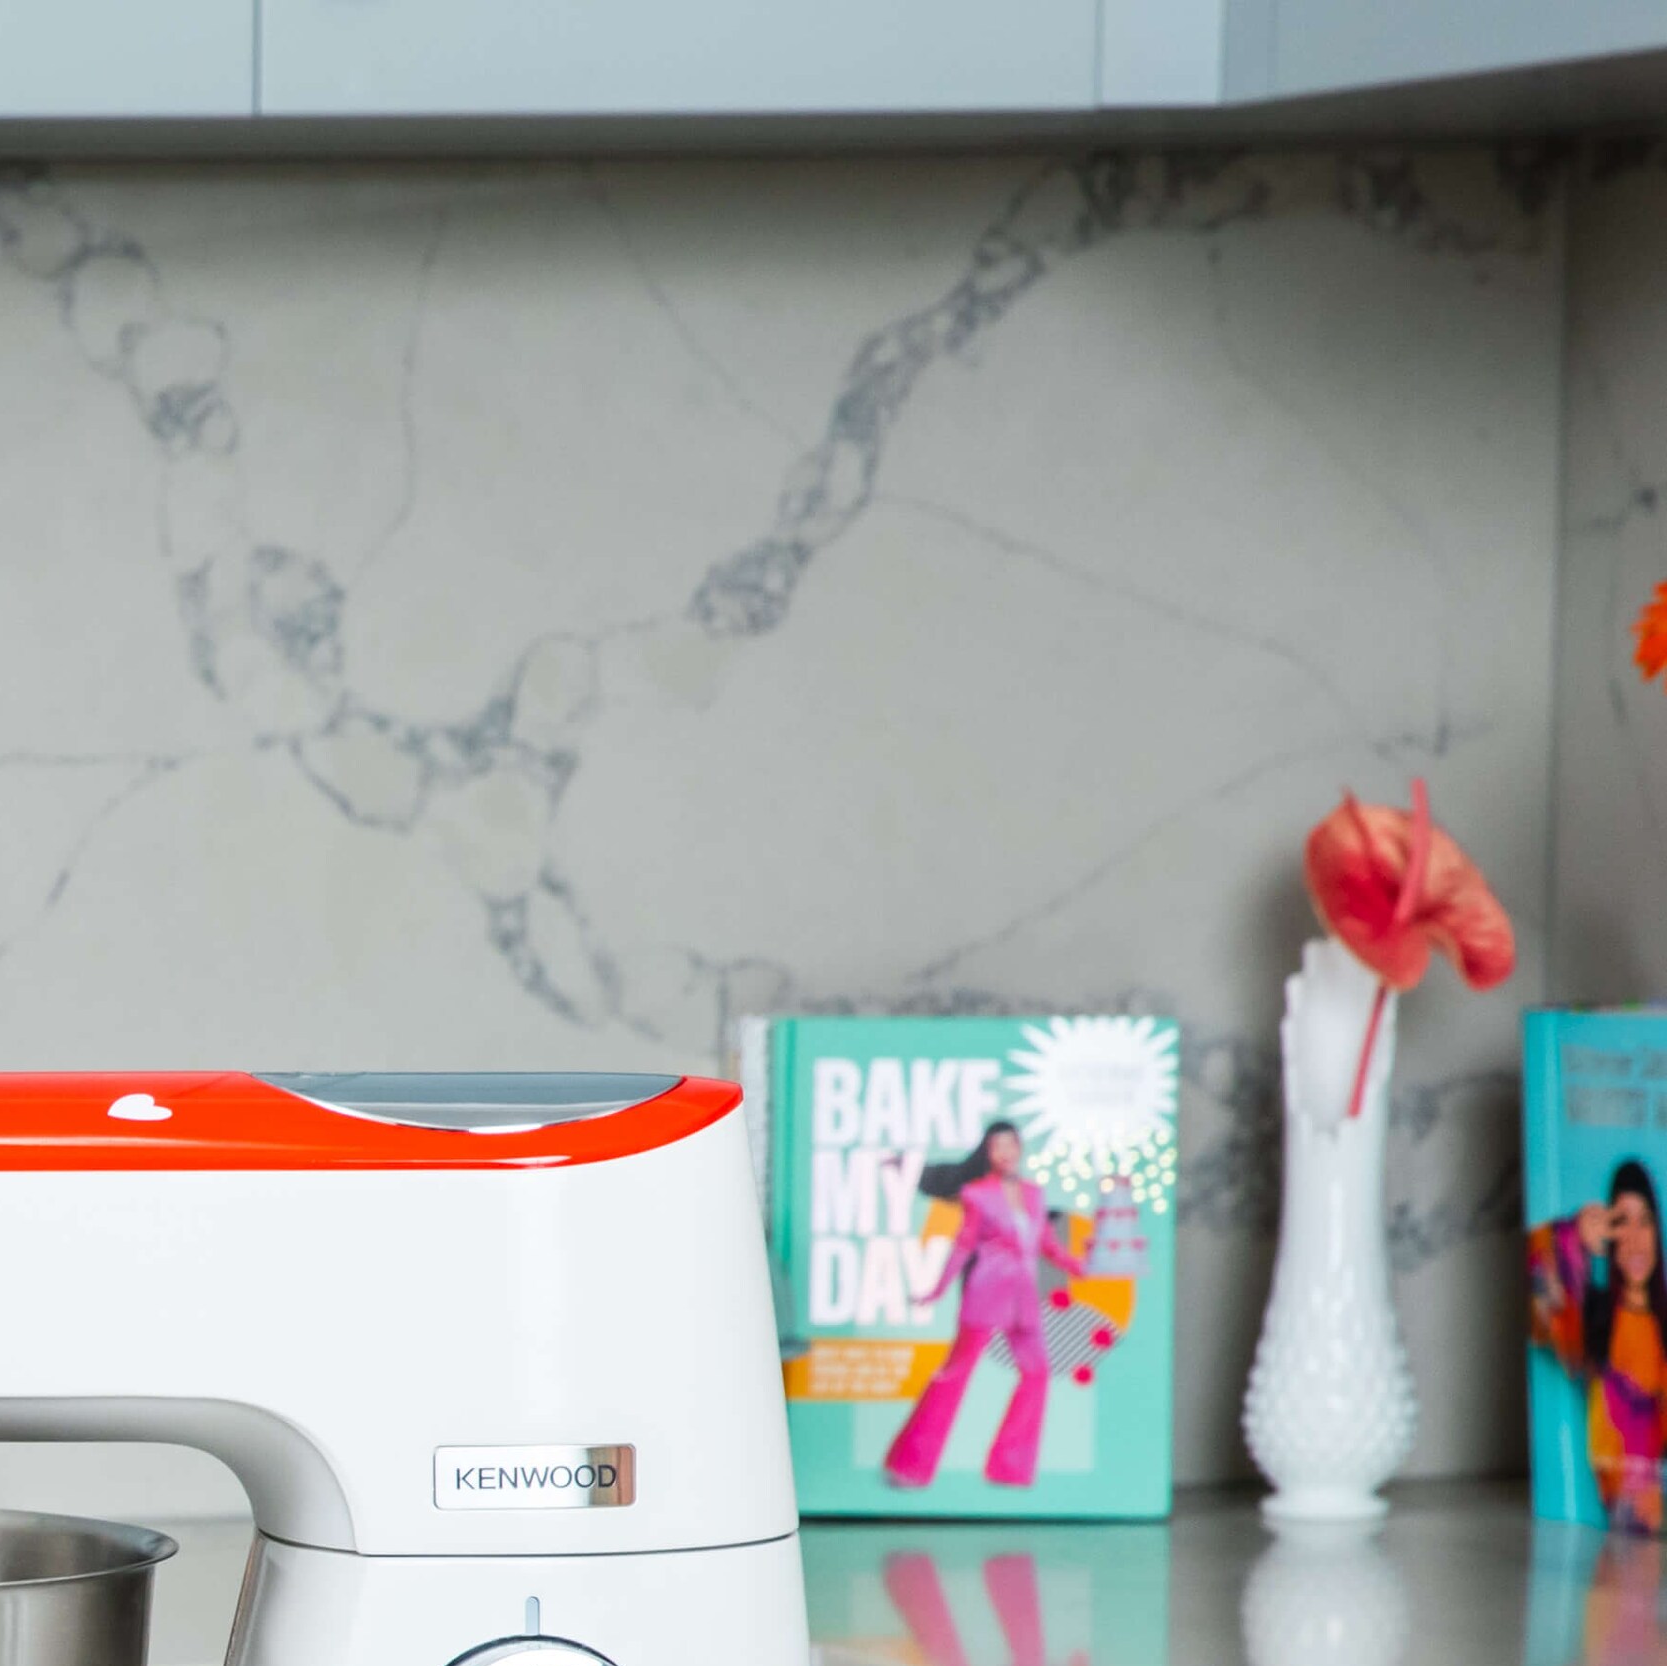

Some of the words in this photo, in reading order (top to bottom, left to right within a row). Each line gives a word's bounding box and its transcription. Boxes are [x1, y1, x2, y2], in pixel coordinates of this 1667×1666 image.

[811, 1149, 926, 1236] MY
[809, 1236, 953, 1326] DAY
[455, 1464, 617, 1490] KENWOOD
